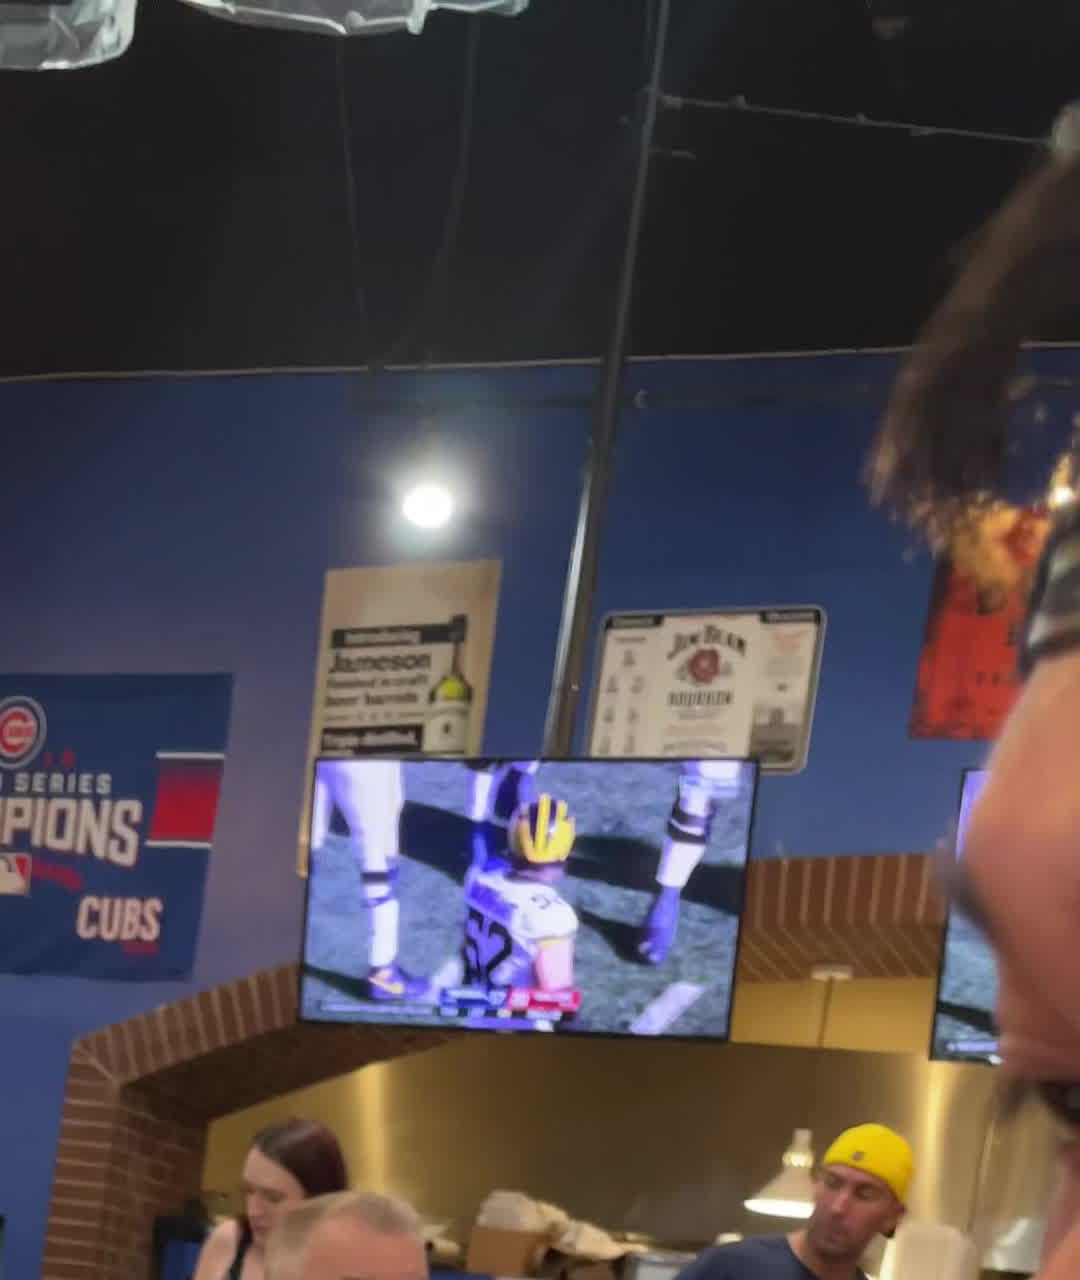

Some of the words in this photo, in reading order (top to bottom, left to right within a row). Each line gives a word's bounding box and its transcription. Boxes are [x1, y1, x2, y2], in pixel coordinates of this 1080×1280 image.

[328, 652, 432, 674] Jameson
[14, 771, 113, 795] SERIES
[76, 895, 163, 942] CUBS
